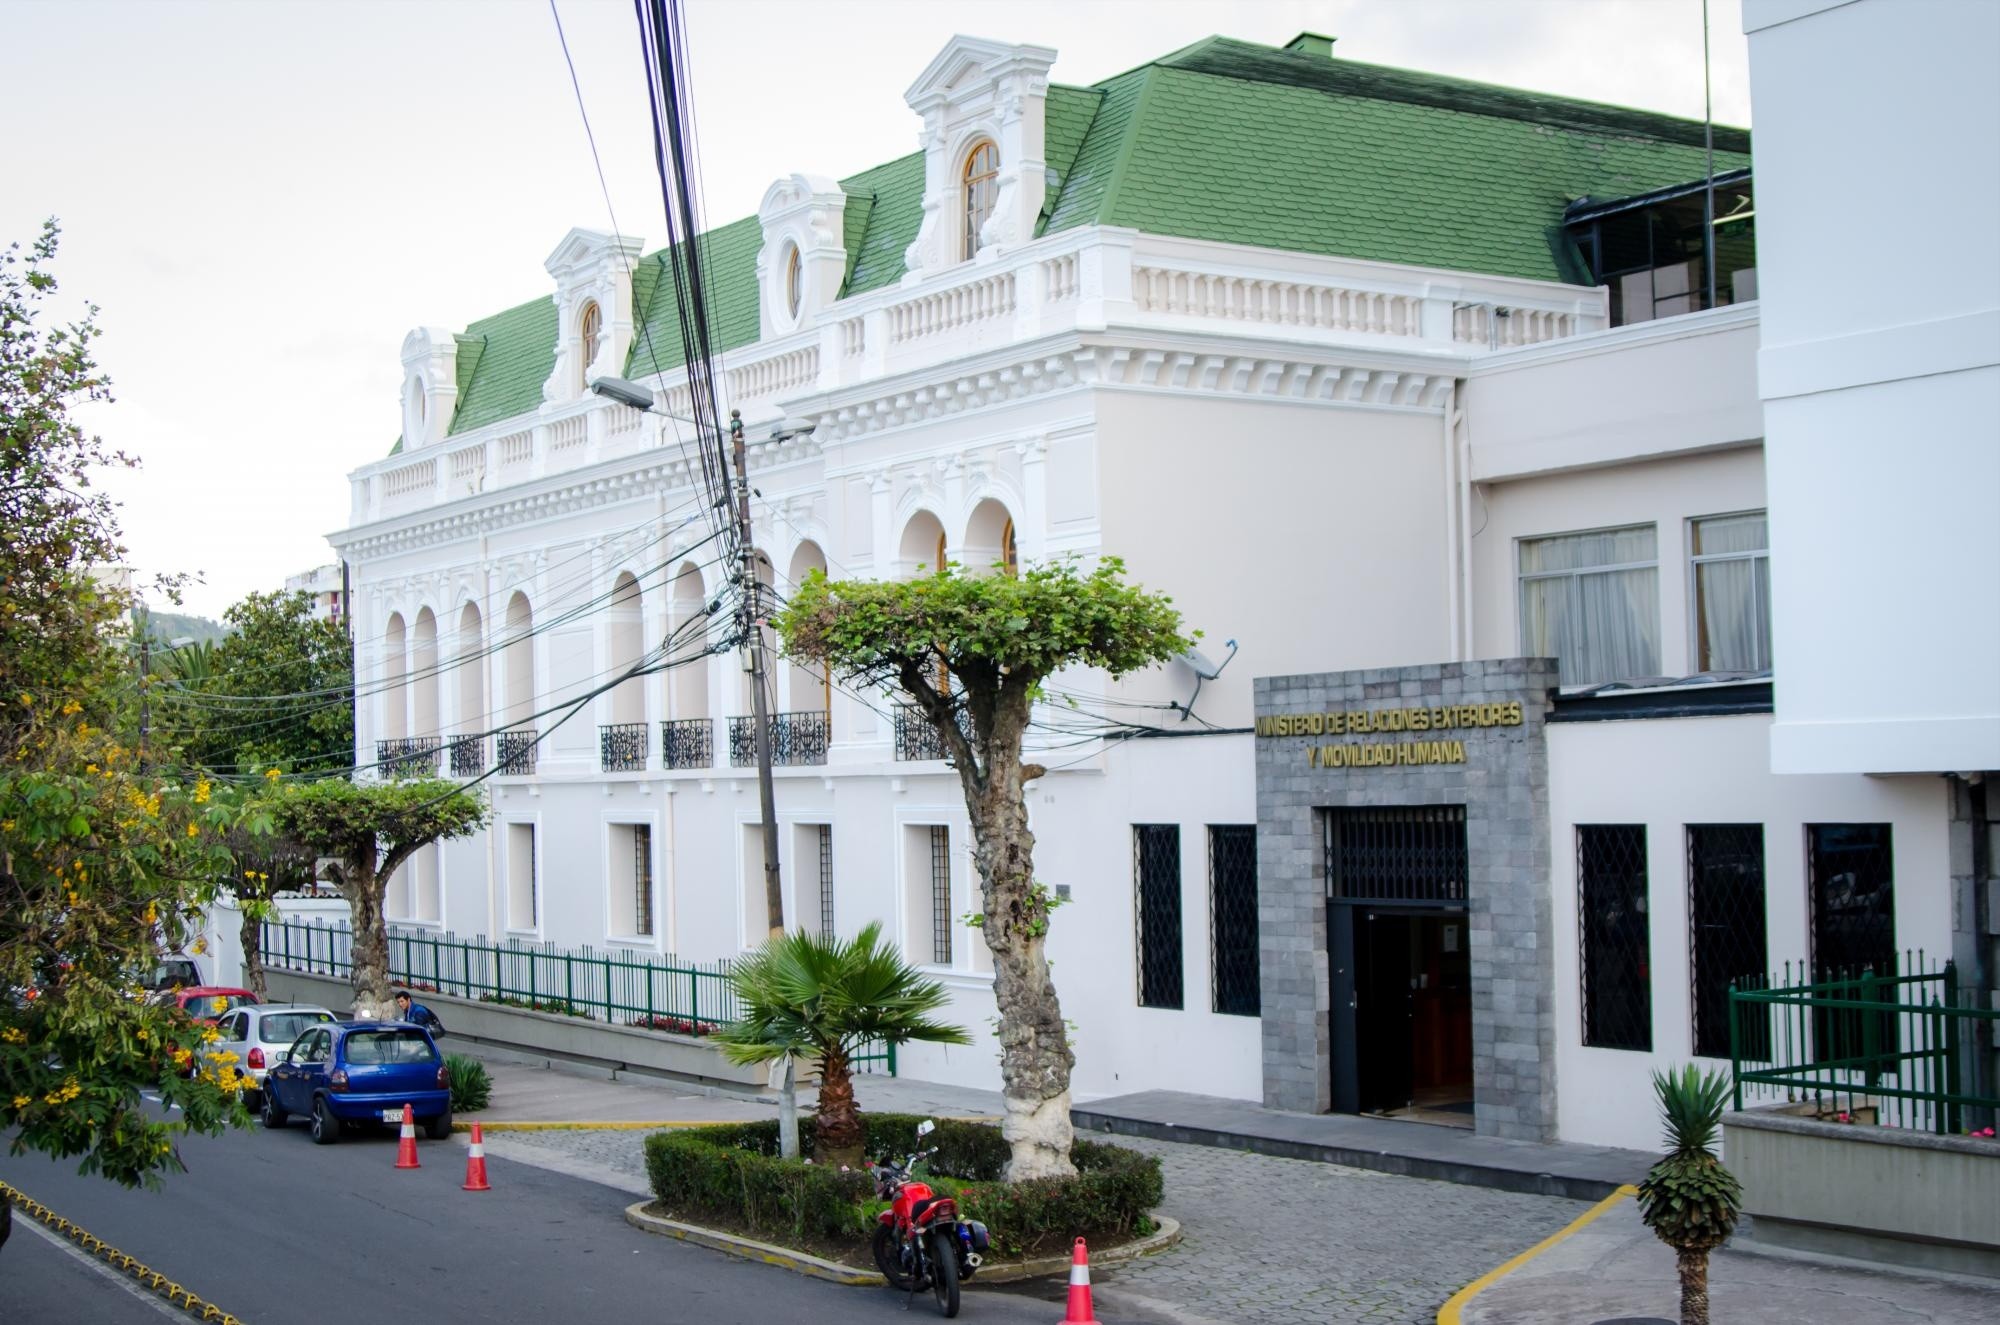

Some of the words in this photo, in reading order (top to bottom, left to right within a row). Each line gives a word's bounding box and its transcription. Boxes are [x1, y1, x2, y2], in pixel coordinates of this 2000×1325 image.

[1256, 713, 1324, 737] MINISTERIO
[1327, 712, 1345, 734] DE
[1347, 706, 1430, 734] RELACIONES
[1431, 702, 1522, 729] EXTERIORES
[1306, 747, 1318, 768] Y
[1322, 743, 1396, 768] MOVILIDAD
[1398, 740, 1466, 765] HUMANA
